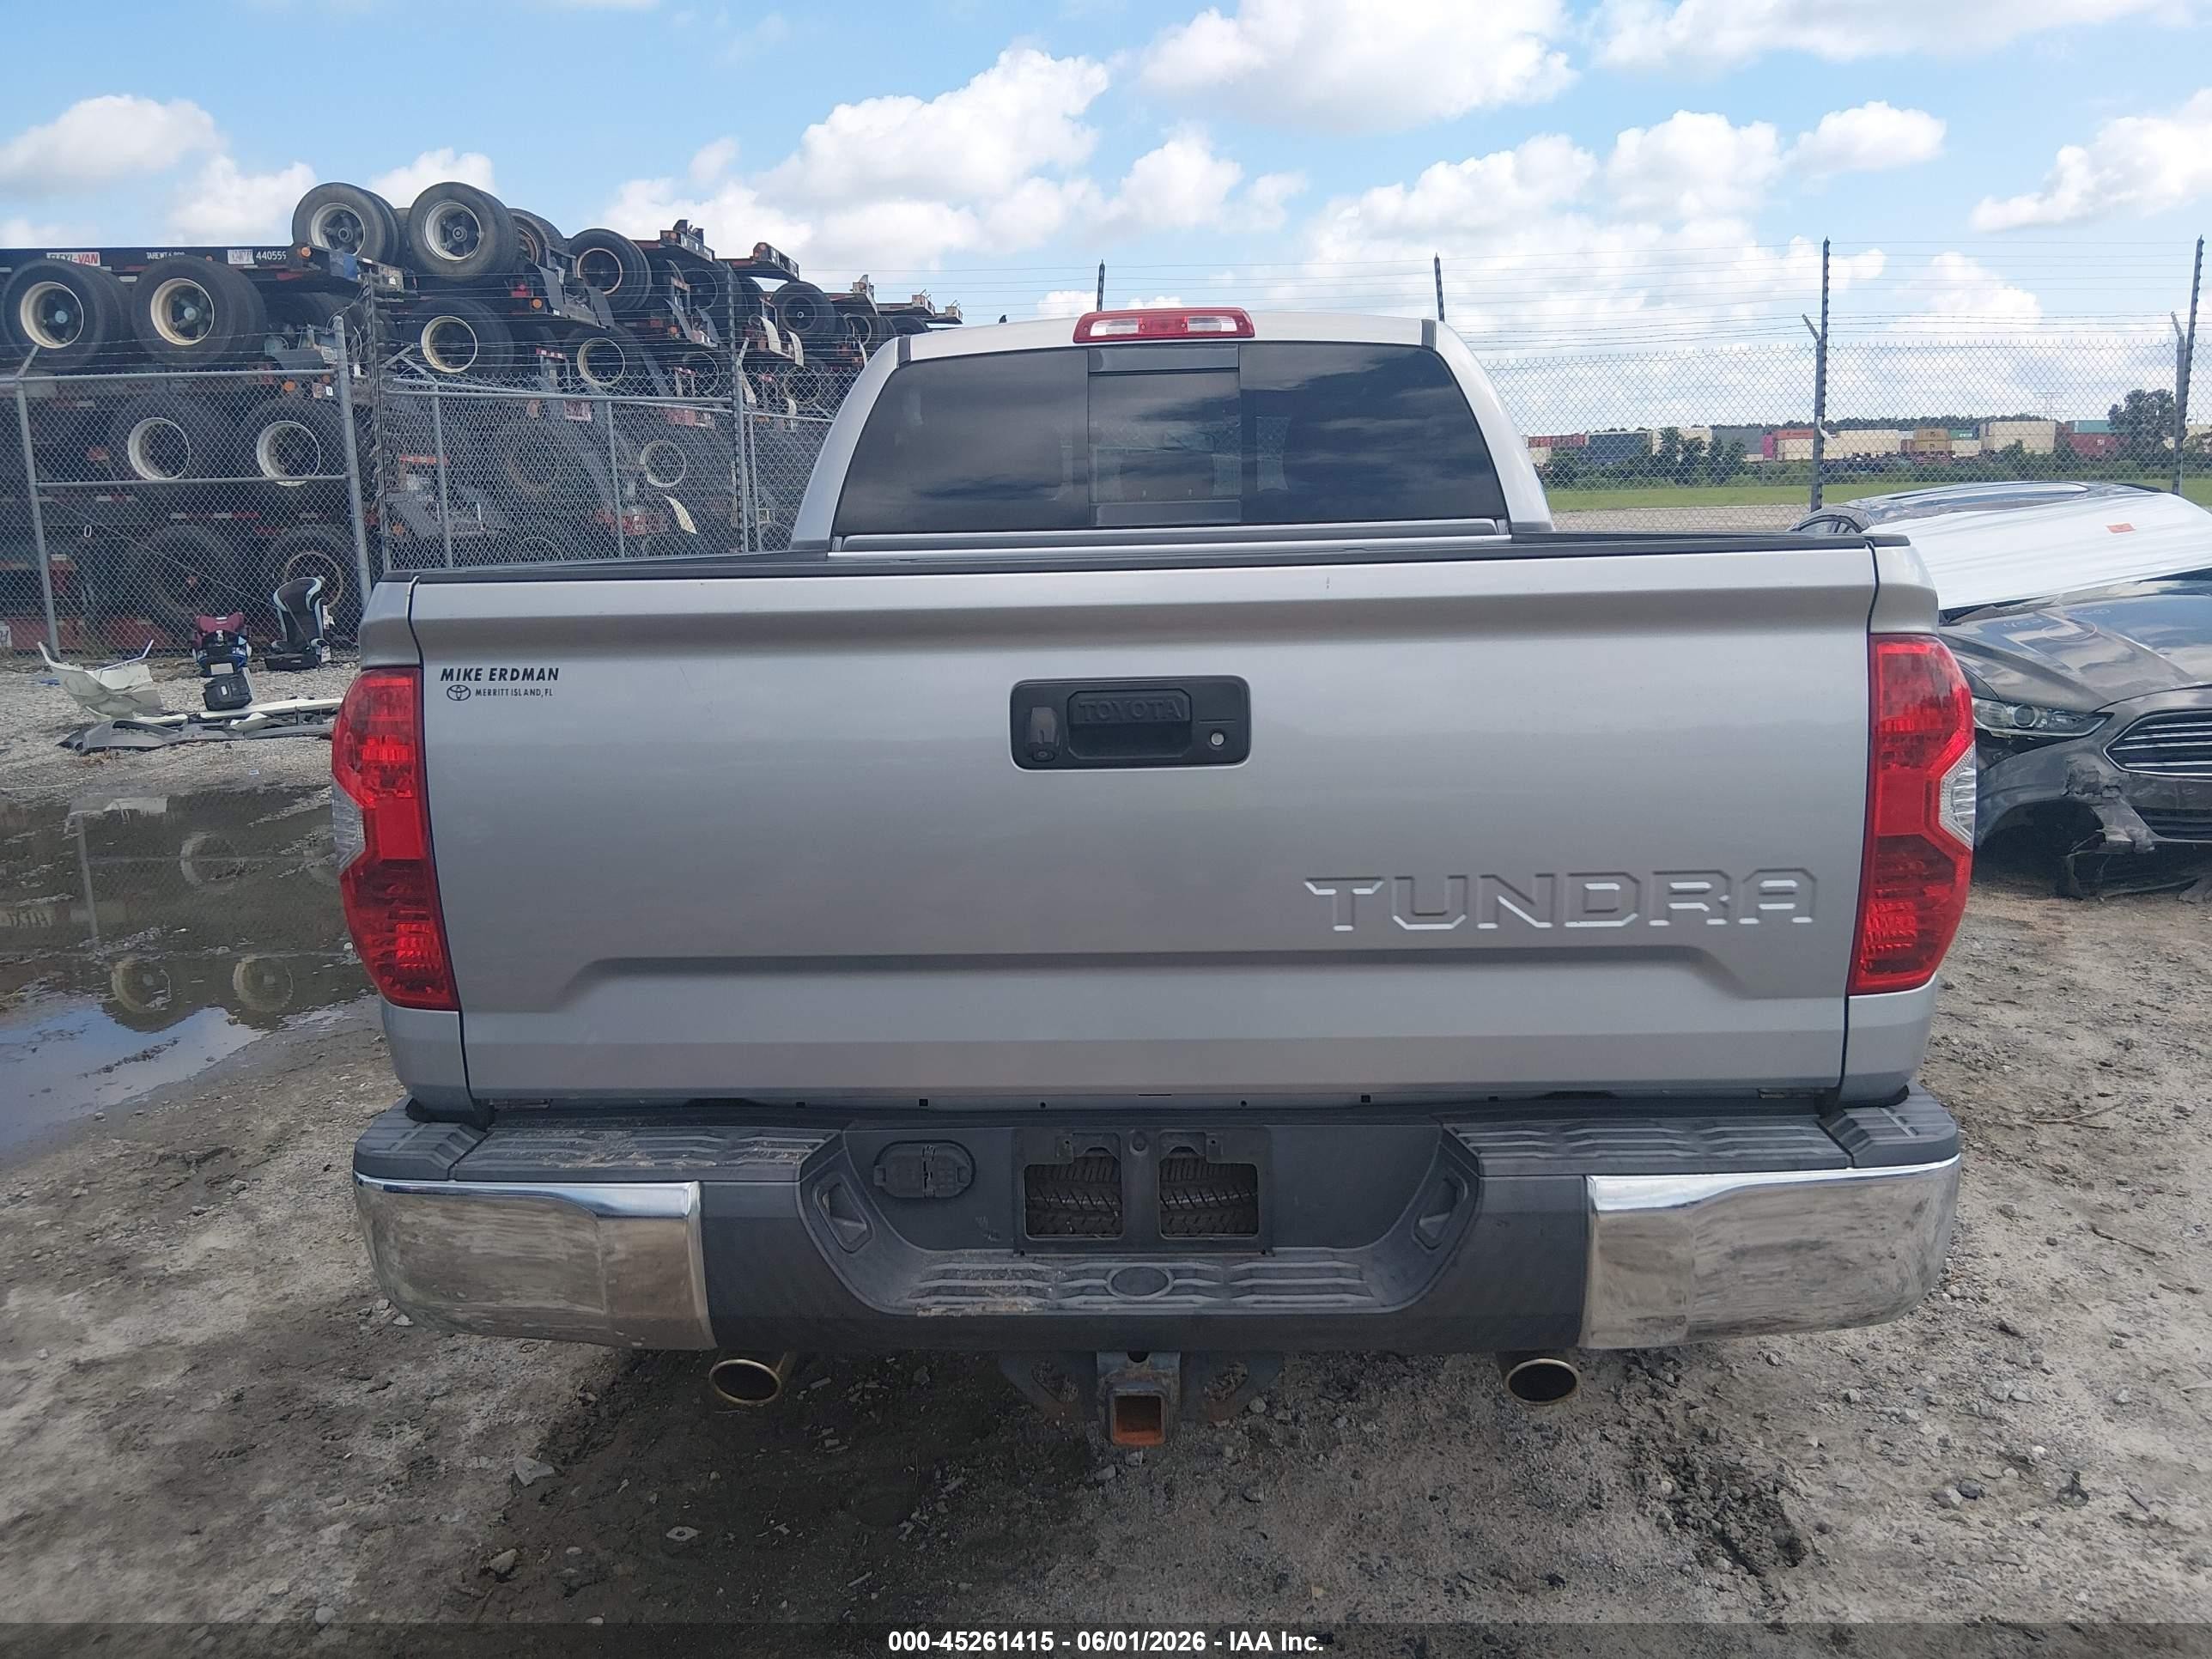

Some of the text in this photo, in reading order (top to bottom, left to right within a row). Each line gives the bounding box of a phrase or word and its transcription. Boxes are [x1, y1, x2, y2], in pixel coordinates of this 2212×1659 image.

[440, 666, 559, 681] MIKE ERDMAN
[475, 688, 508, 697] MERRITT
[1078, 699, 1182, 722] TOYOTA
[1304, 866, 1818, 932] TUNDRA
